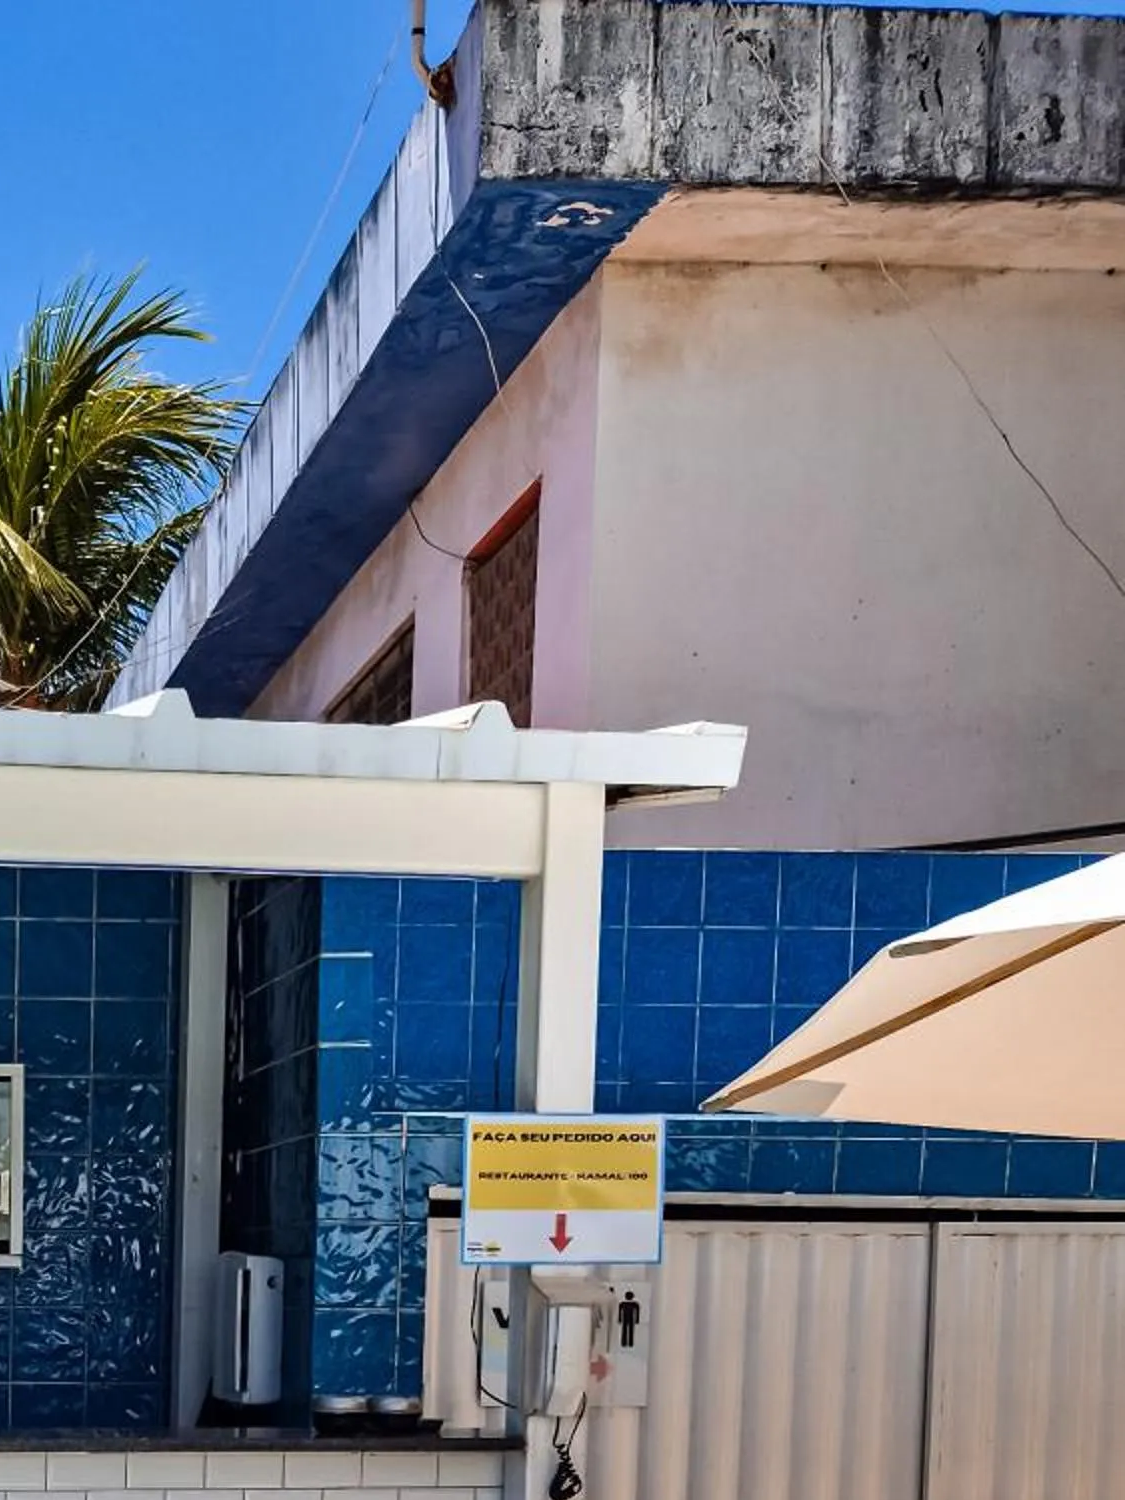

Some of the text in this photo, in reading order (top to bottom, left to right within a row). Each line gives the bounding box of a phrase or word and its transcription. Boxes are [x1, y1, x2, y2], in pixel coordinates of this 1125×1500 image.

[473, 1132, 656, 1144] FAÇA SEU PEDIDO AQUI
[478, 1172, 569, 1181] RESTAURANTE
